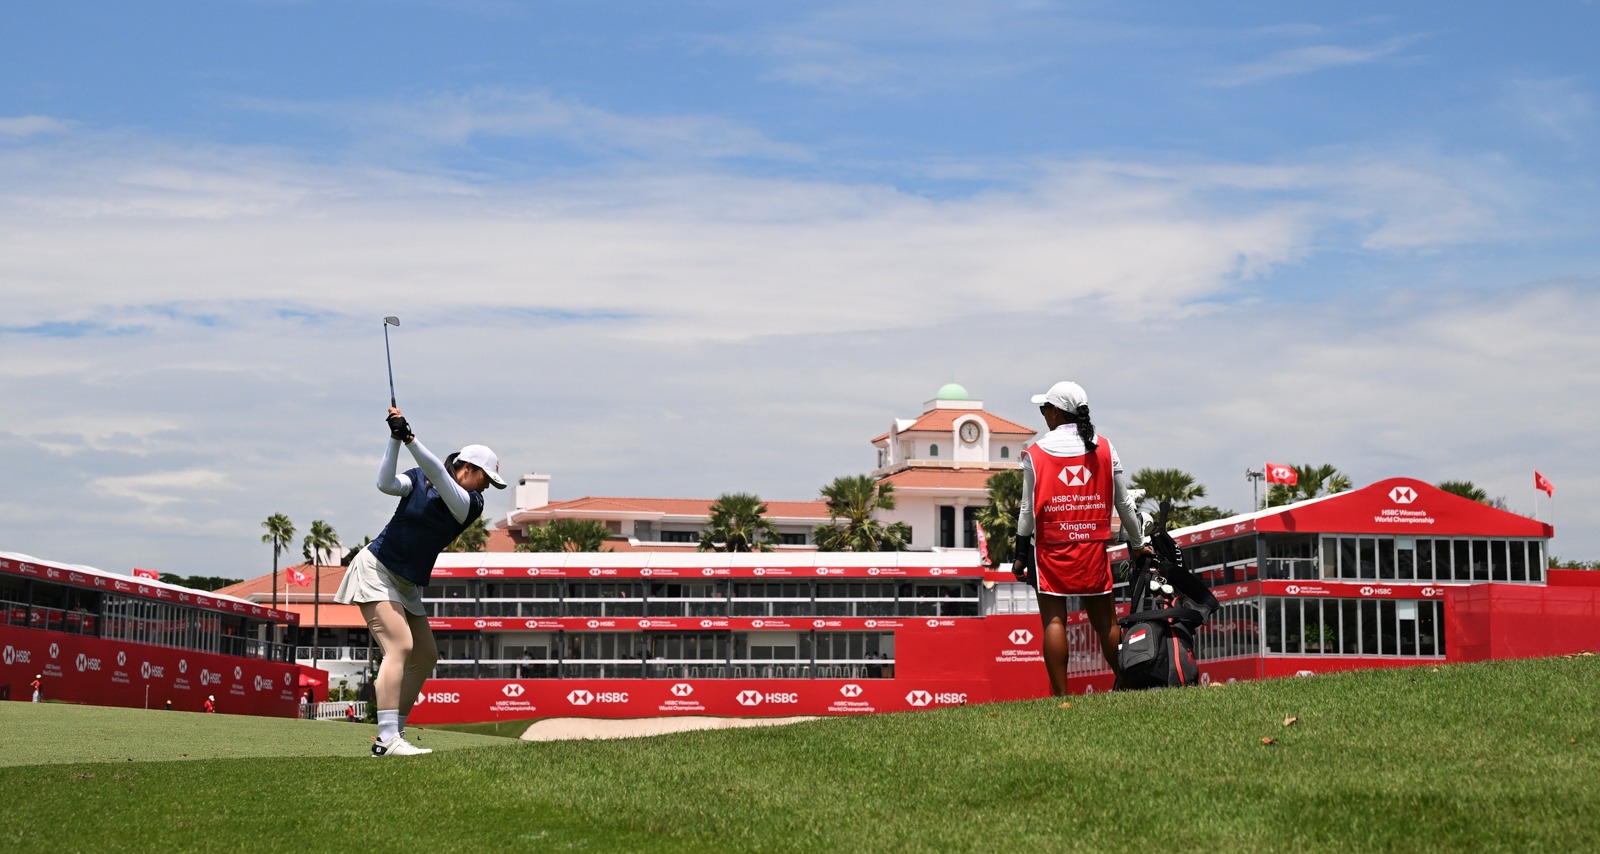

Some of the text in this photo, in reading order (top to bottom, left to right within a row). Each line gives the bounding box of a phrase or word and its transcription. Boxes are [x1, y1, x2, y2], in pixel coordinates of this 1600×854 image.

[1065, 502, 1106, 511] Championshi
[16, 650, 30, 663] HSBC
[428, 693, 460, 703] HSBC
[596, 693, 628, 702] HSBC
[766, 693, 798, 703] HSBC
[935, 693, 967, 704] HSBC
